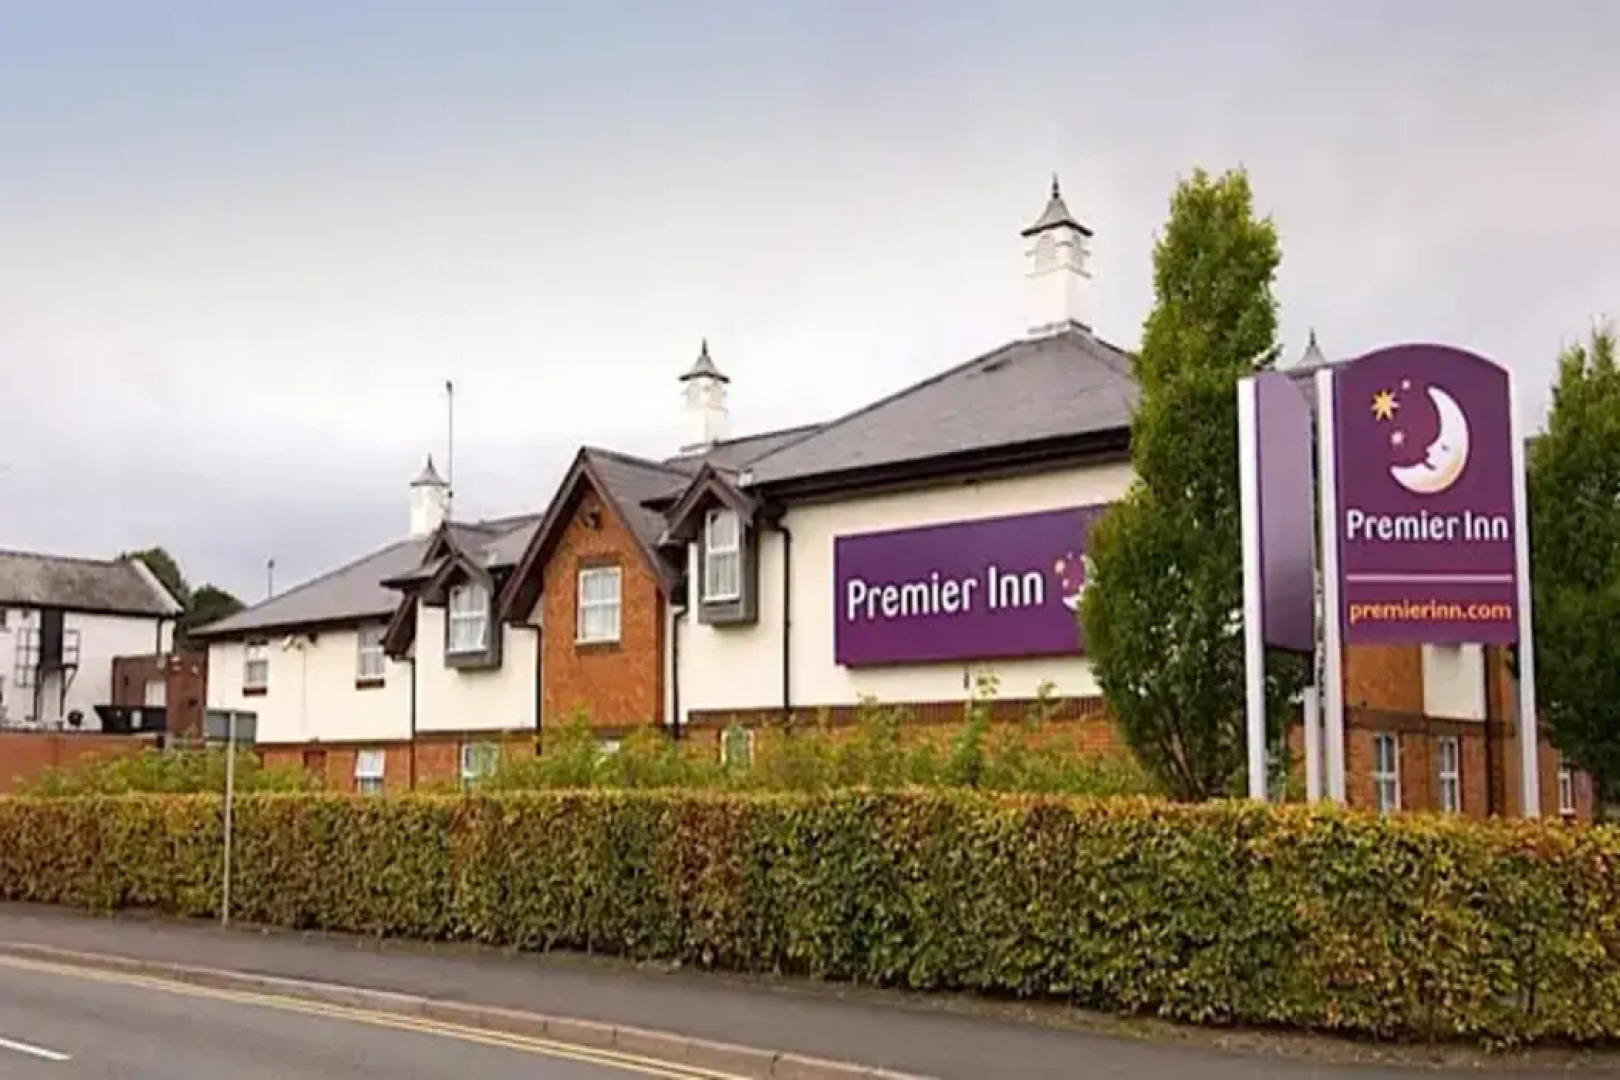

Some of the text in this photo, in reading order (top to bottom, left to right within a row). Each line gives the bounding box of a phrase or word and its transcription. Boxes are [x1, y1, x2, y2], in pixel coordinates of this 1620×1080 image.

[1346, 508, 1510, 541] Premier Inn
[846, 565, 1044, 621] Premier Inn
[1349, 598, 1513, 625] premierinn.com
